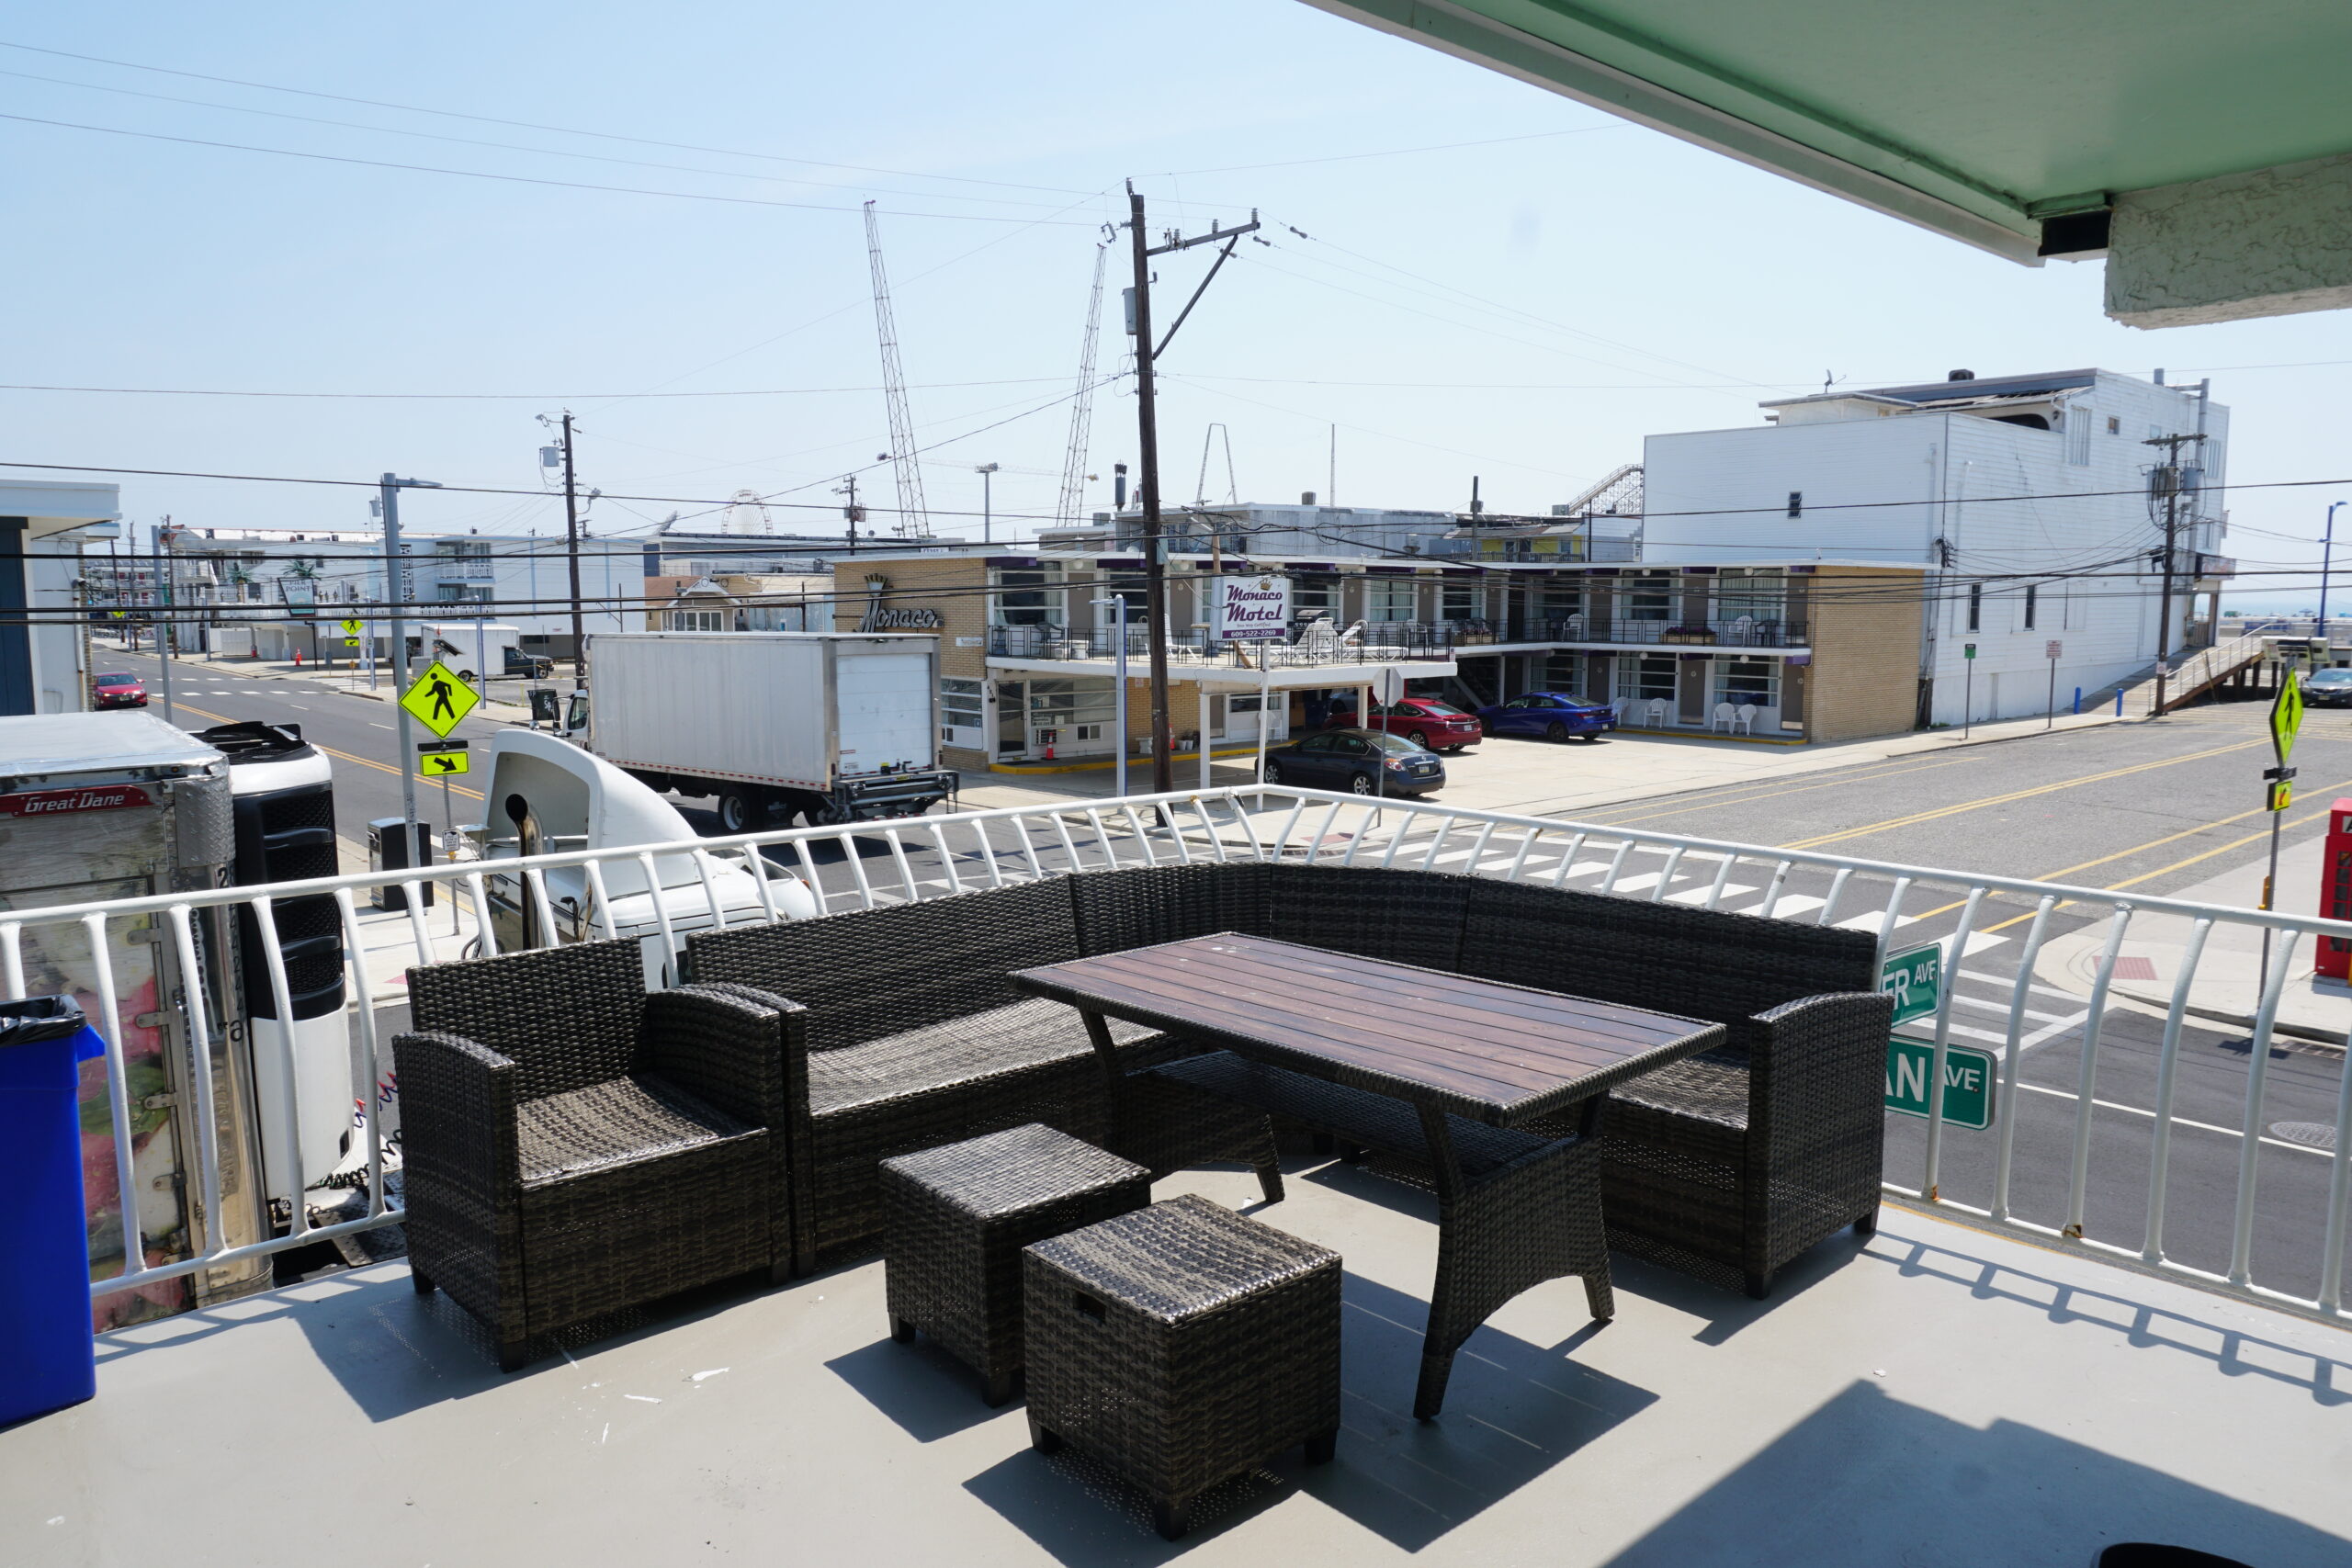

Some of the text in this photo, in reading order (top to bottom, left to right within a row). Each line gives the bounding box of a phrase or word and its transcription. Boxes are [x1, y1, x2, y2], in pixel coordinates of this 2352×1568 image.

[1227, 584, 1283, 602] Monaco
[854, 595, 937, 633] Monaco
[1227, 603, 1283, 622] Motel
[25, 792, 125, 813] Great Dane
[1914, 959, 1937, 986] AVE
